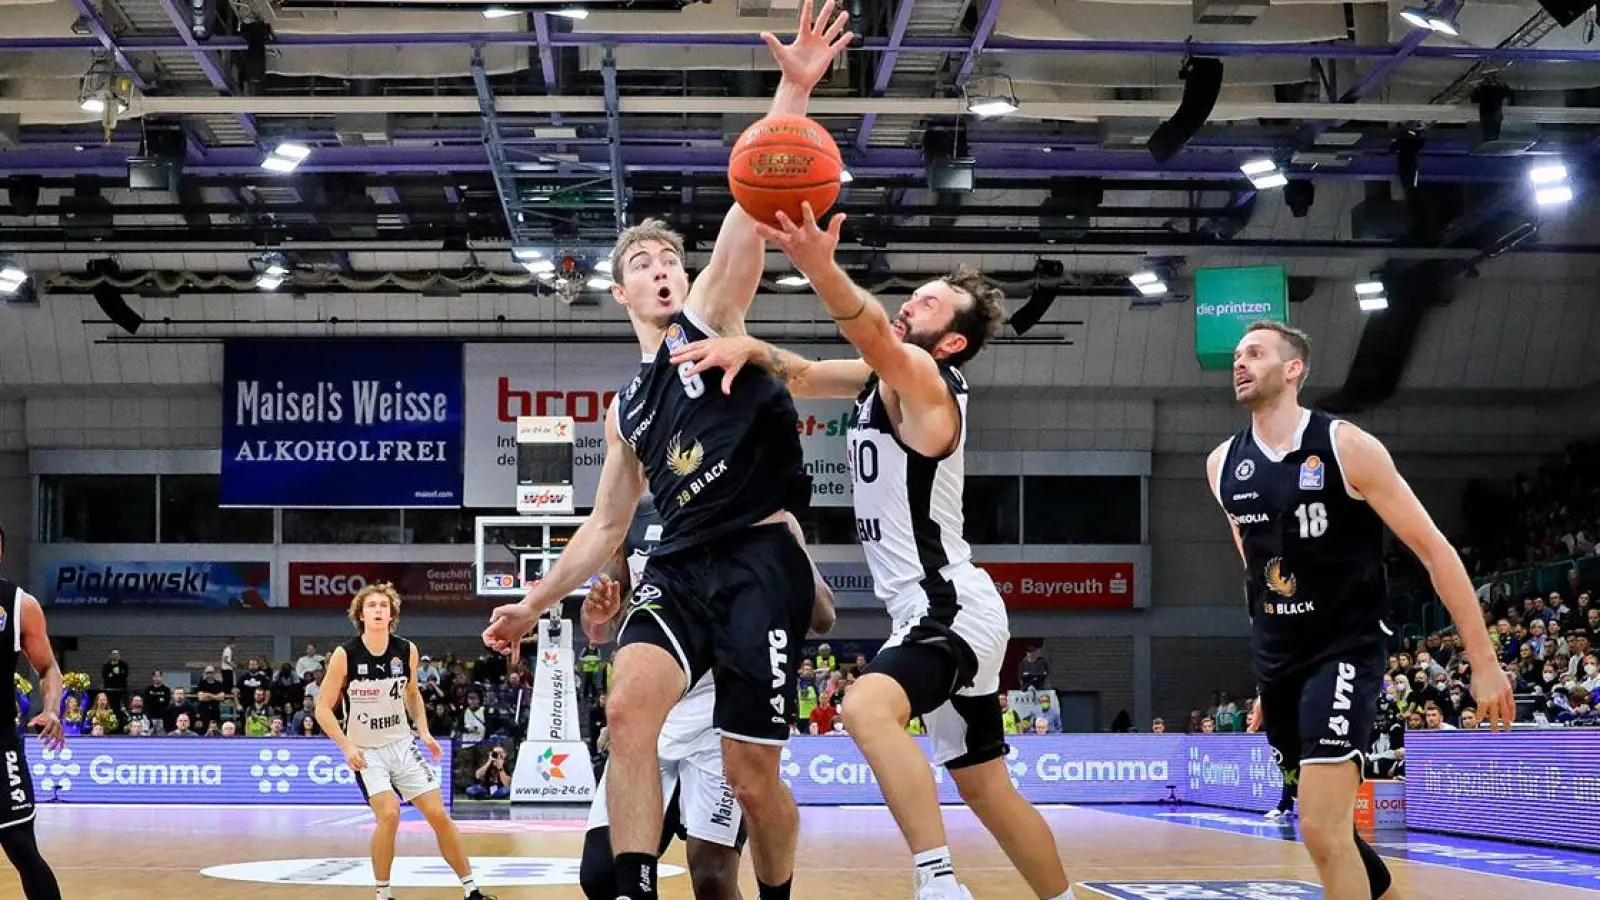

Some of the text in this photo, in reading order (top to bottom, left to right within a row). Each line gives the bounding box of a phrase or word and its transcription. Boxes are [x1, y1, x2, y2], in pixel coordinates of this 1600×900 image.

[1196, 303, 1215, 316] die
[1216, 301, 1271, 317] printzen
[236, 380, 447, 426] Maisel's Weisse
[235, 440, 447, 461] ALKOHOLFREI
[689, 458, 728, 495] BLACK
[1294, 501, 1329, 539] 18
[56, 565, 209, 593] Piotrowski
[299, 574, 367, 595] ERGO
[1020, 578, 1102, 597] Bayreuth
[1276, 600, 1315, 615] BLACK
[768, 629, 788, 688] VTG
[1332, 662, 1356, 710] VTG
[550, 669, 563, 740] Piotrowski
[5, 750, 21, 787] VTG
[89, 754, 222, 785] Gamma
[1035, 753, 1169, 781] Gamma
[515, 785, 590, 797] www.pio-24.de
